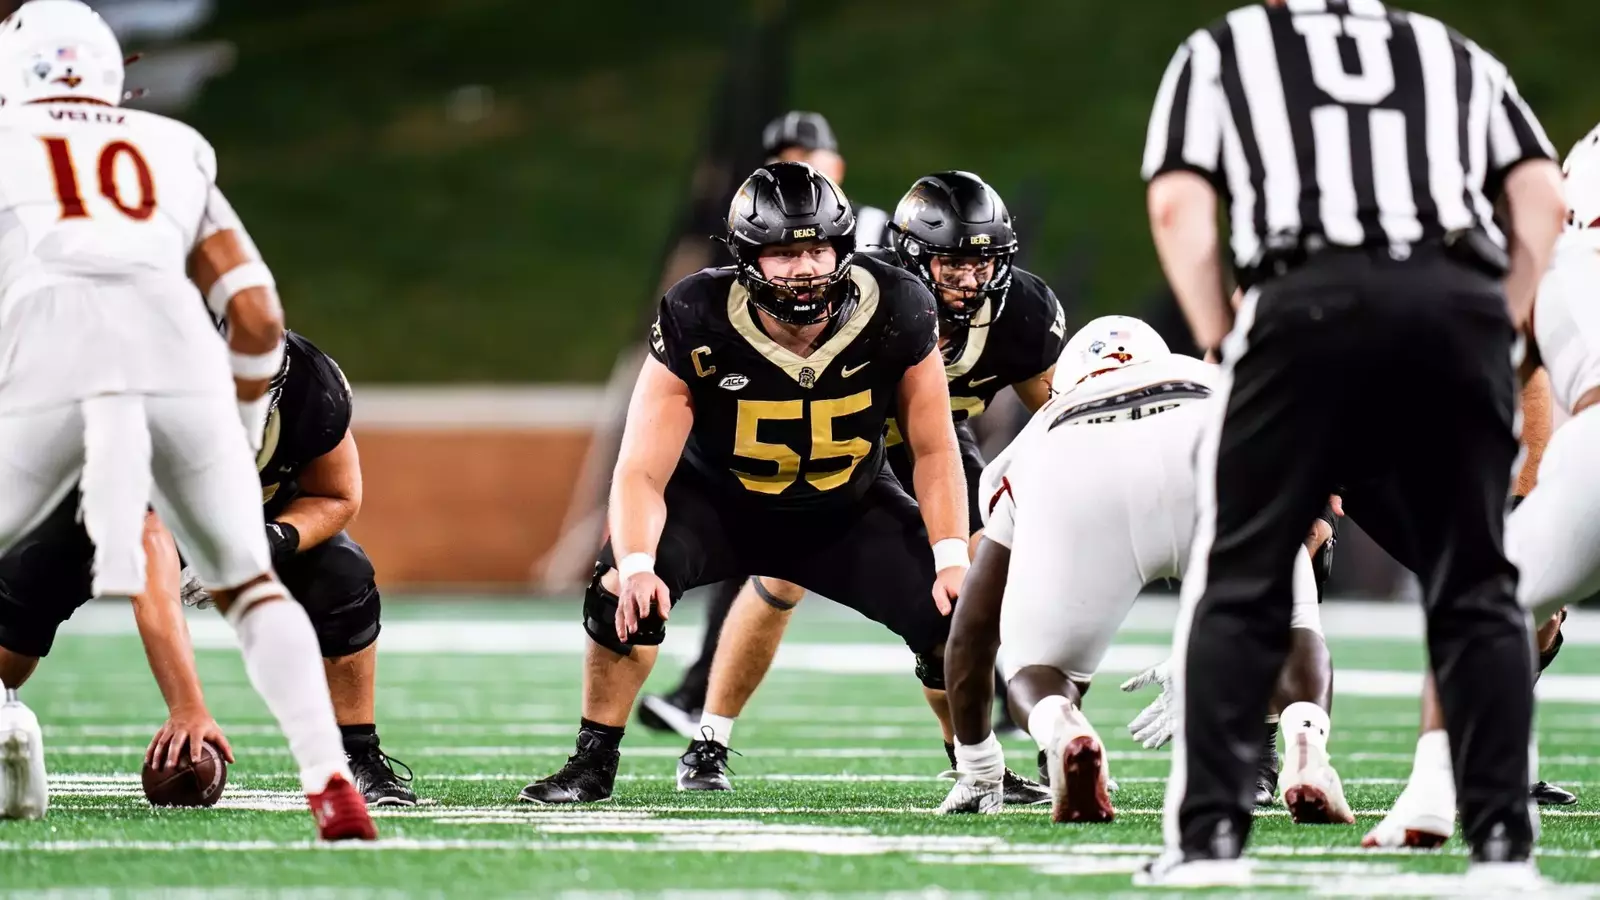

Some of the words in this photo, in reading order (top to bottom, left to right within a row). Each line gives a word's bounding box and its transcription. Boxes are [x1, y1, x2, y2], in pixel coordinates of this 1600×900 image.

[1291, 12, 1395, 106] U
[36, 135, 156, 221] 10
[793, 228, 816, 239] DEACS
[691, 345, 716, 377] C
[723, 377, 746, 387] ACC
[729, 389, 872, 495] 55
